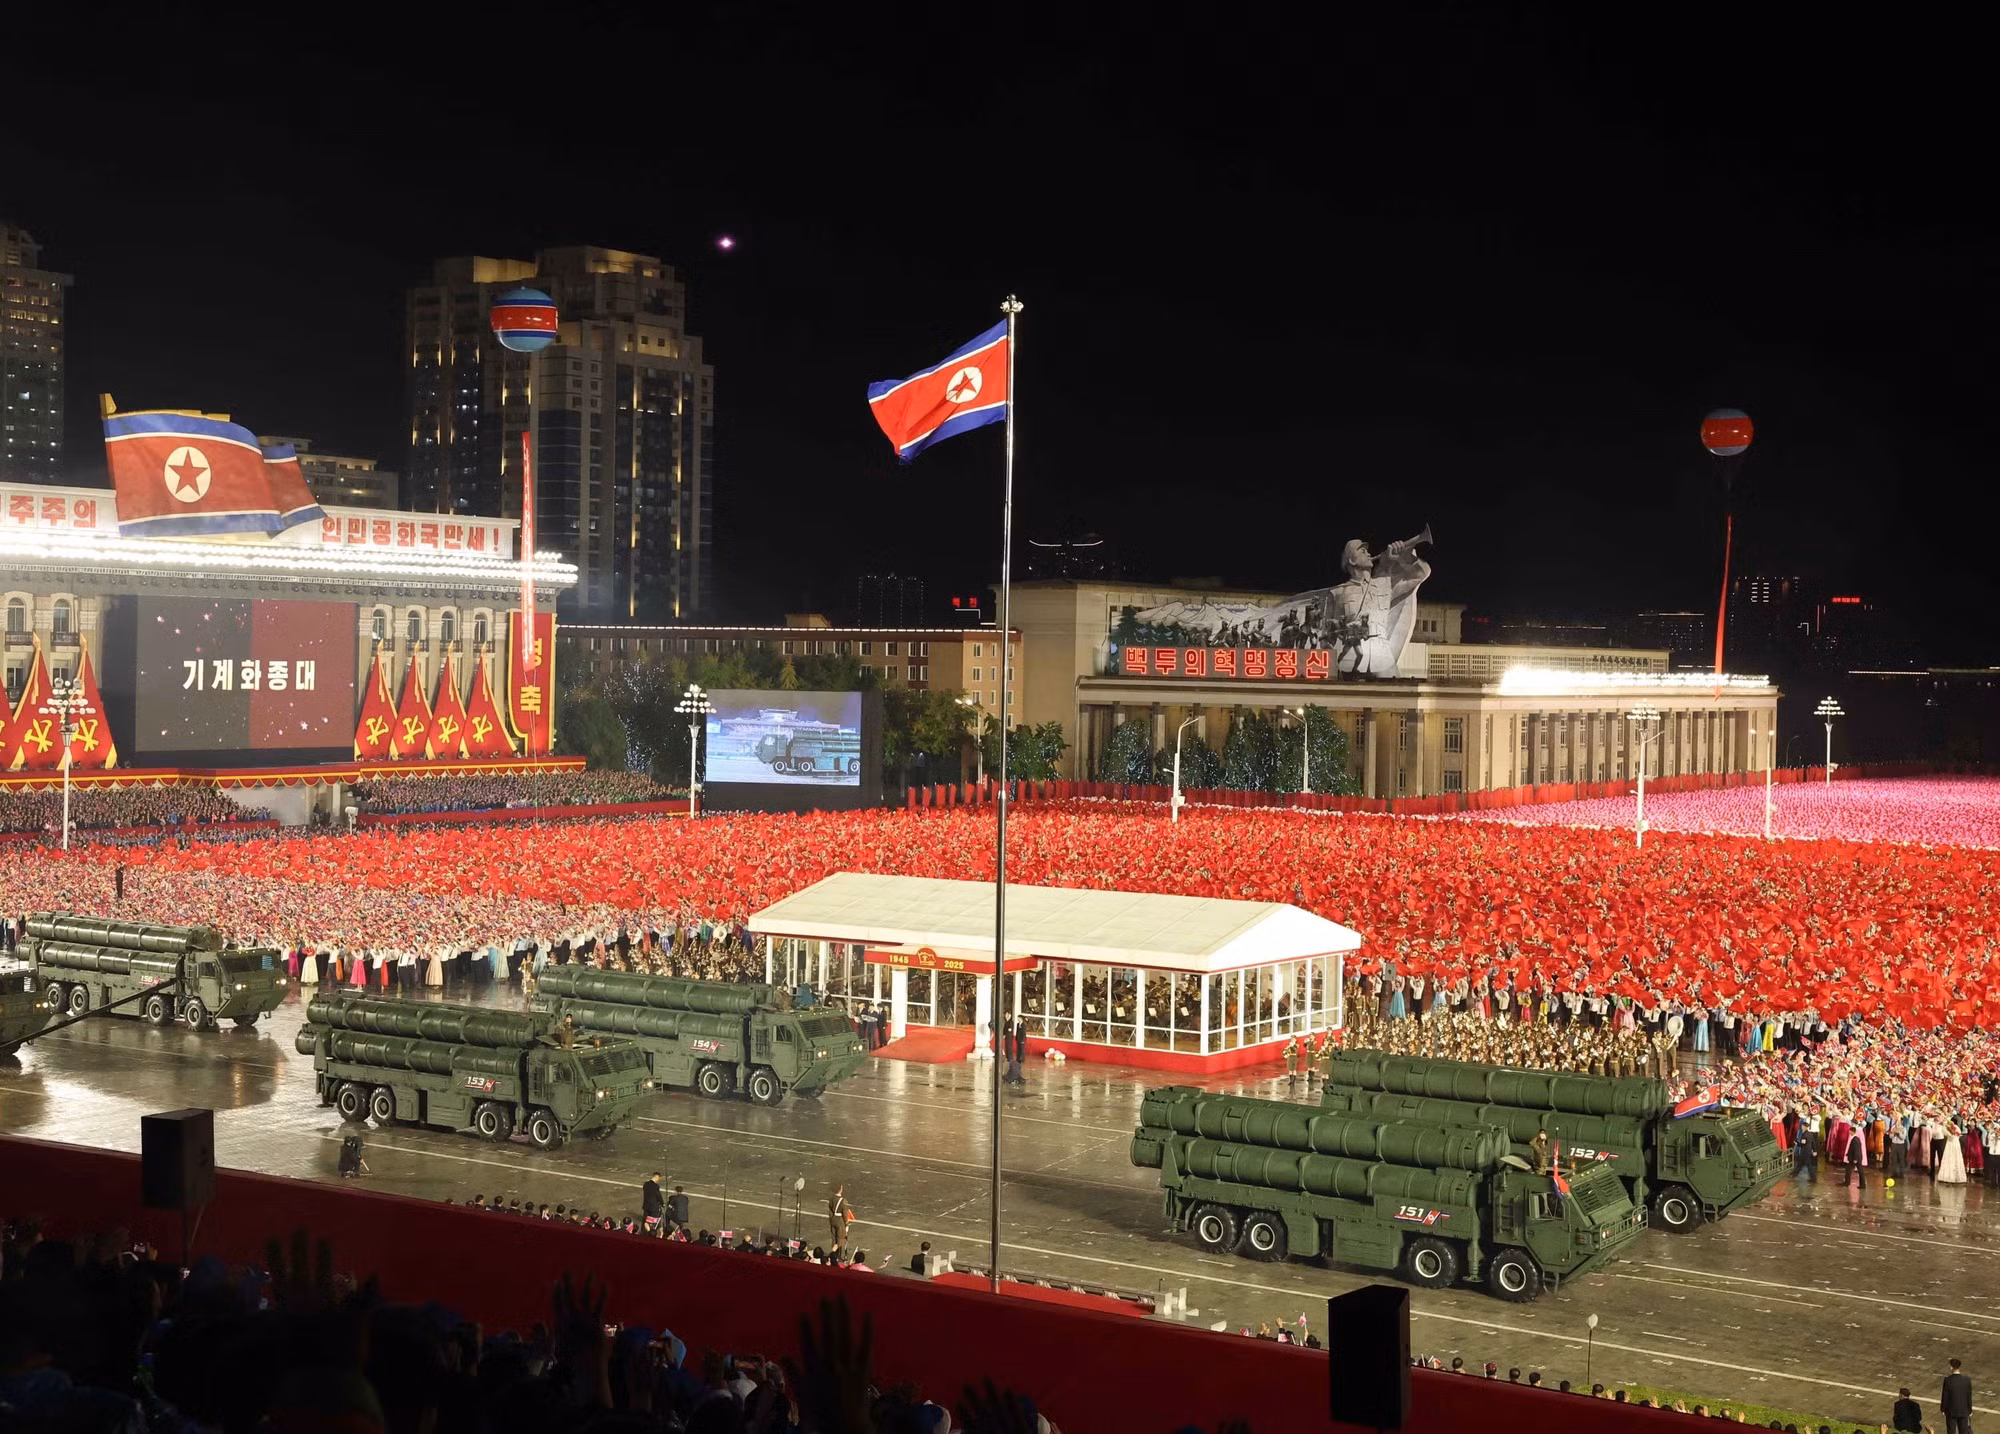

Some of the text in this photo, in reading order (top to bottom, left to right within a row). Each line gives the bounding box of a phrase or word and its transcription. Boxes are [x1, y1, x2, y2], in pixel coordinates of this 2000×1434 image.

[0, 494, 96, 528] 주주의
[182, 659, 315, 691] 기계화종대
[889, 954, 909, 963] 1945
[944, 960, 964, 970] 2025
[693, 1039, 710, 1049] 154
[467, 1076, 485, 1086] 153
[1569, 1147, 1595, 1158] 152
[1399, 1205, 1424, 1218] 151
